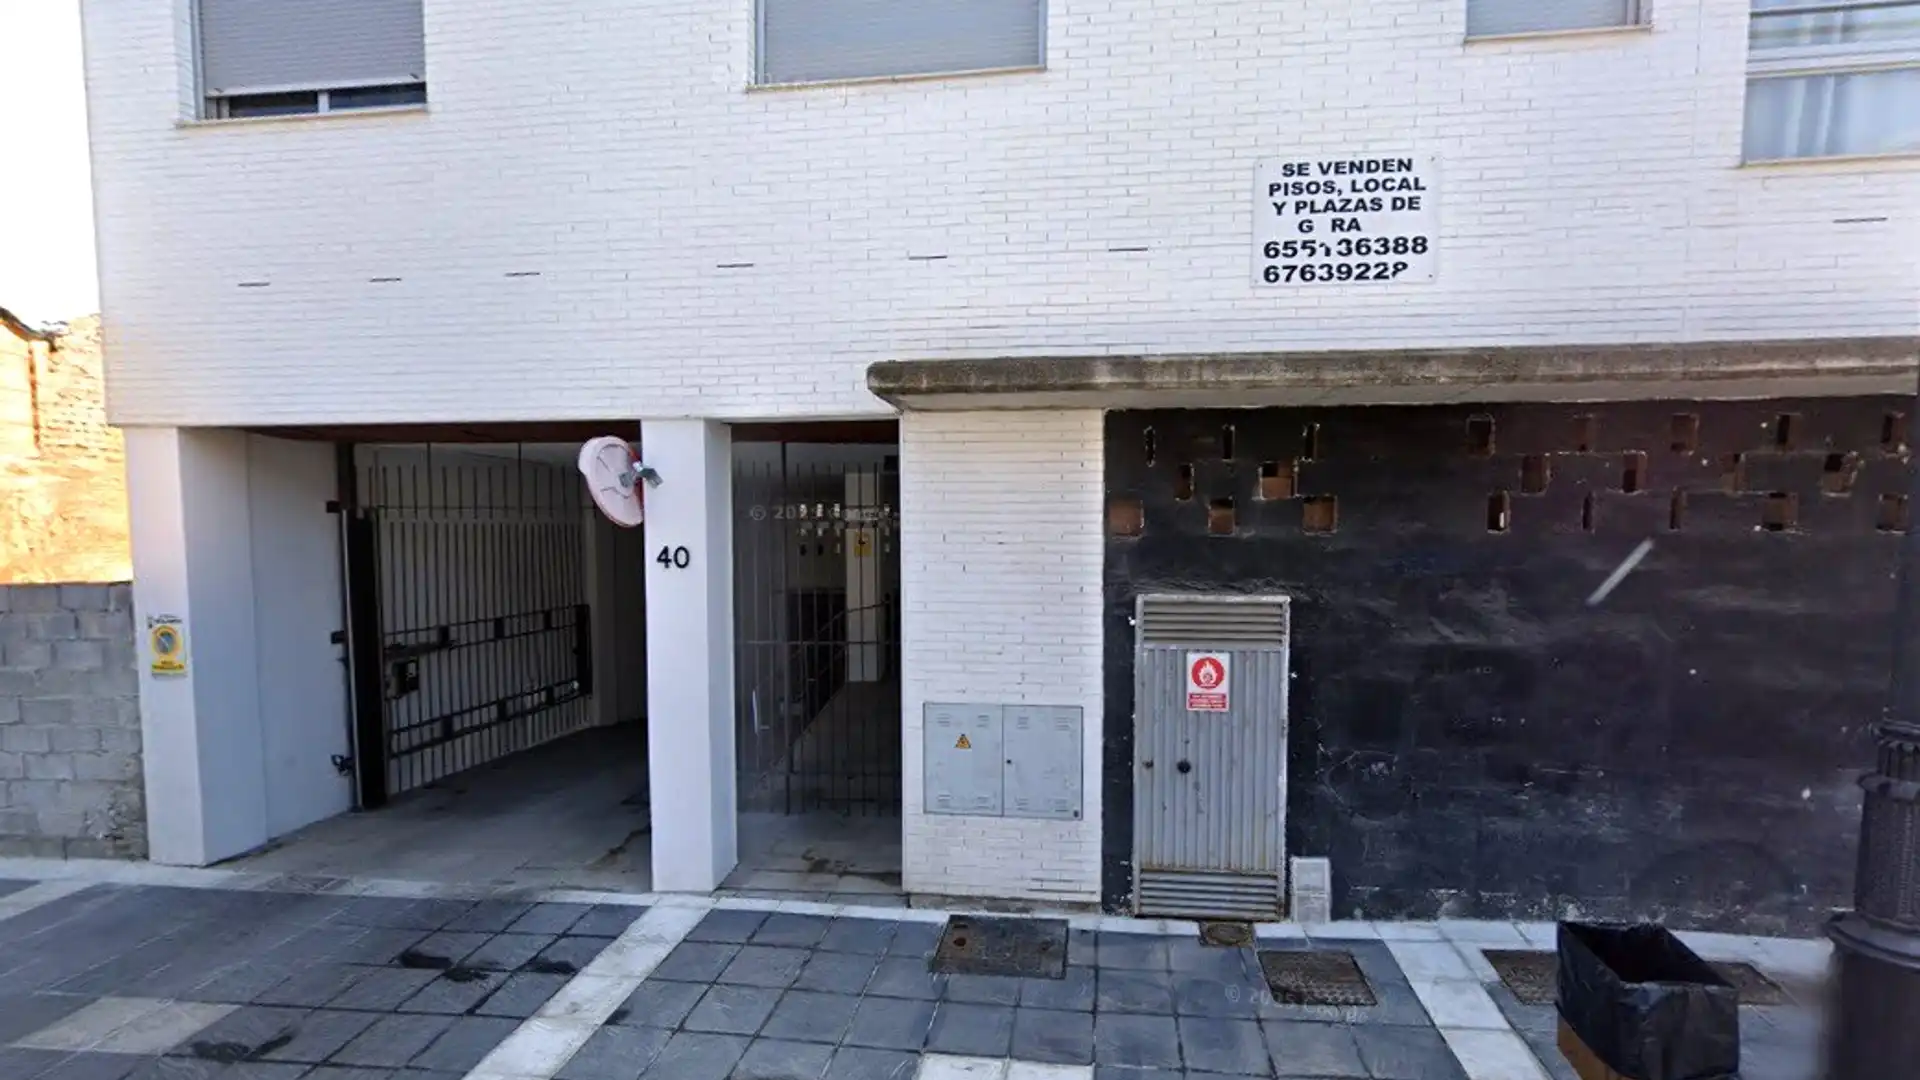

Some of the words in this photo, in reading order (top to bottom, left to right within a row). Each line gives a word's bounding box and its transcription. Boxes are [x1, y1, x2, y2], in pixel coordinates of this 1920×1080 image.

[1281, 162, 1310, 177] SE
[1317, 158, 1413, 176] VENDEN
[1268, 180, 1343, 197] PISOS,
[1351, 177, 1427, 193] LOCAL
[1272, 201, 1287, 216] Y
[1294, 197, 1383, 215] PLAZAS
[1391, 196, 1421, 211] DE
[656, 545, 690, 569] 40
